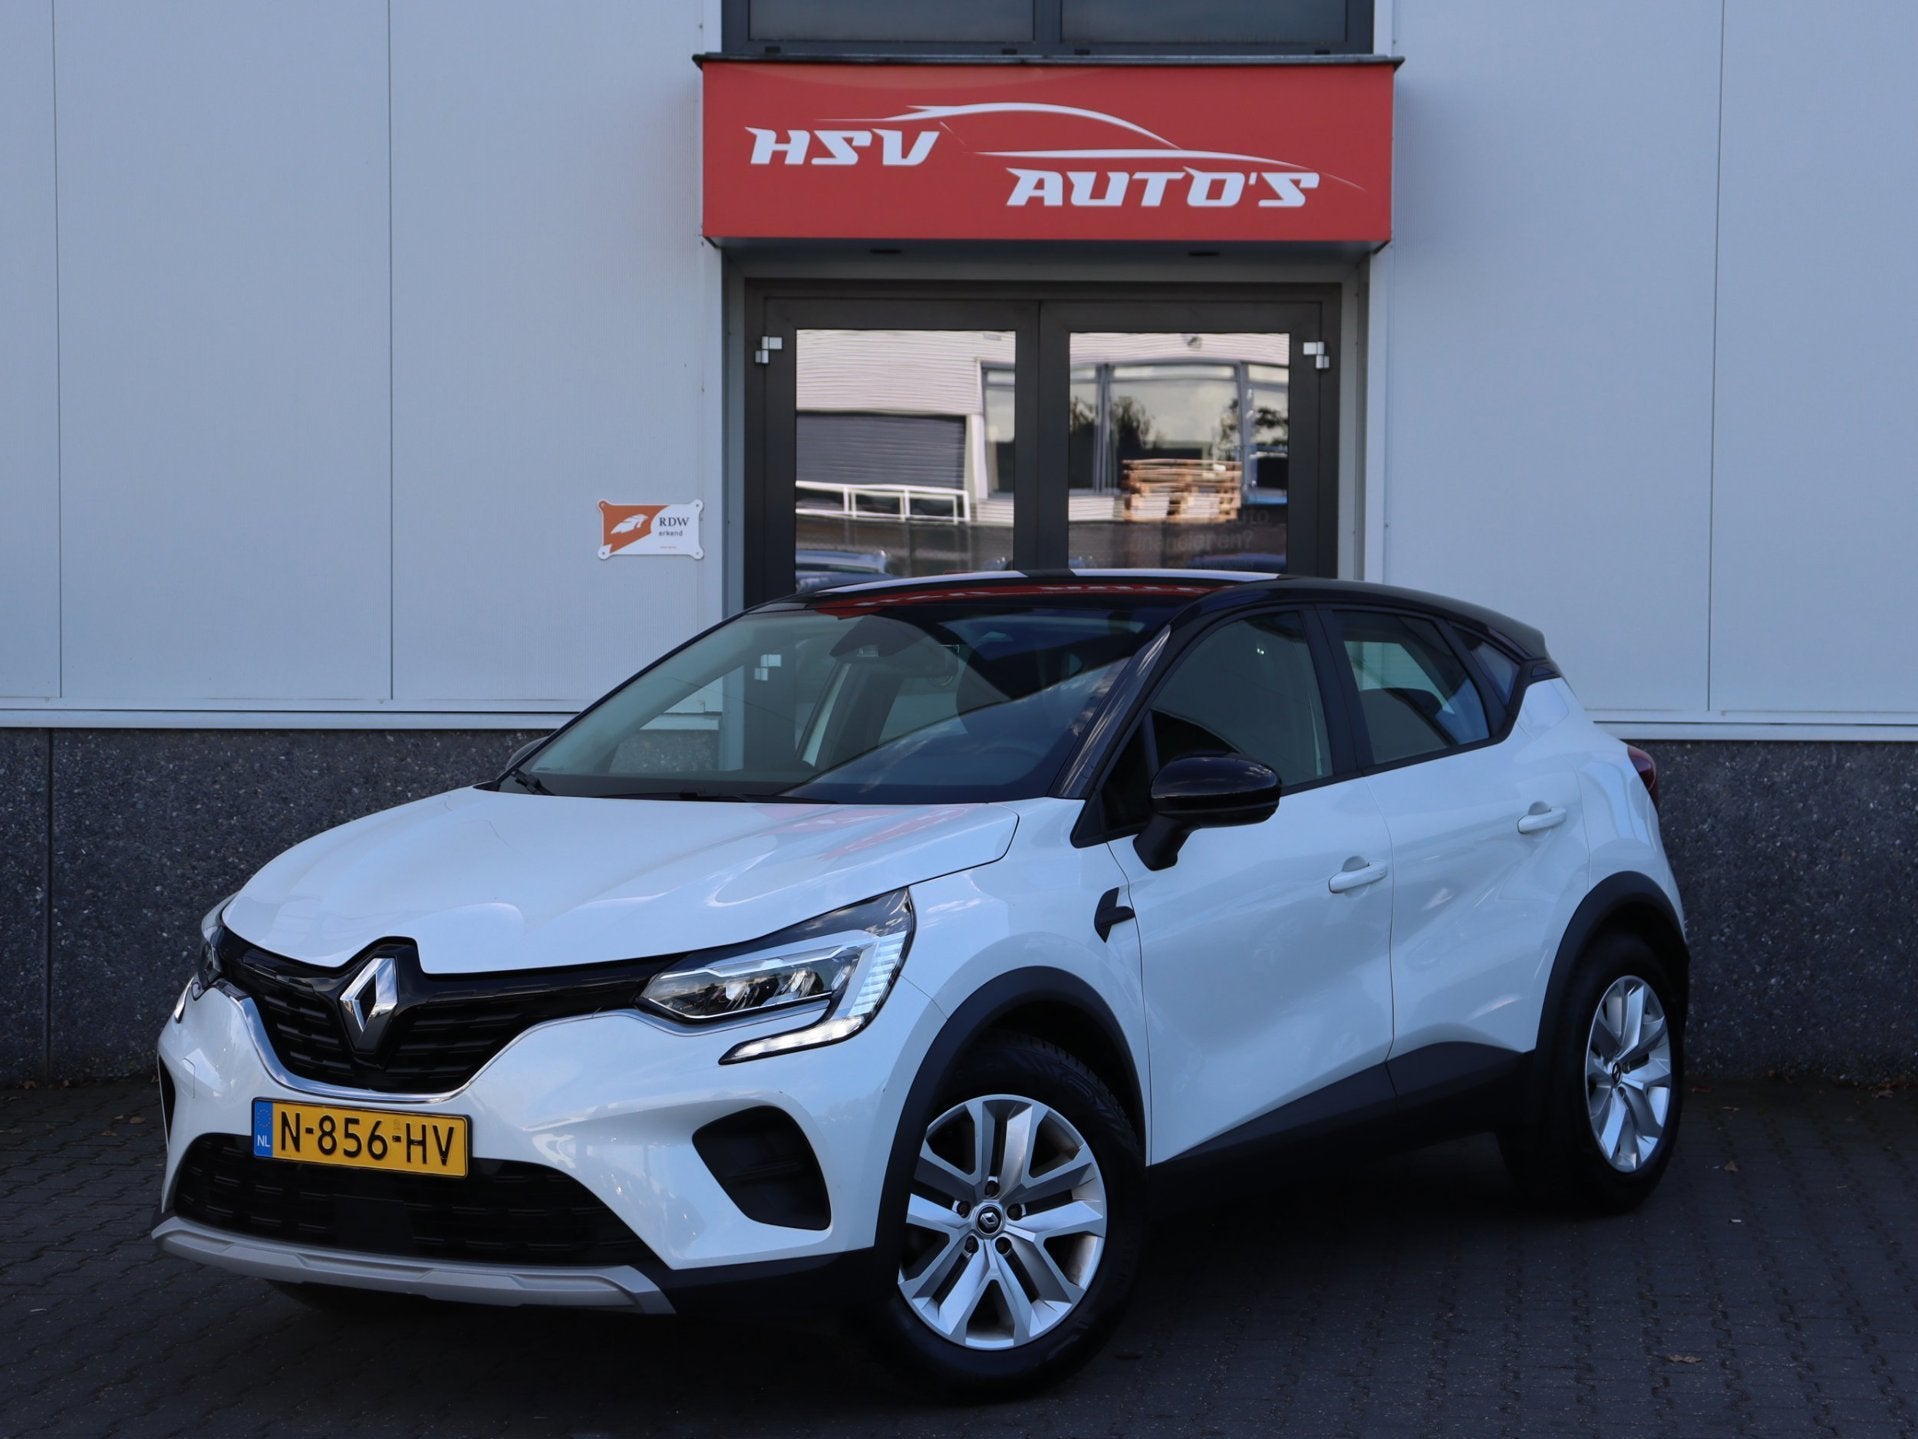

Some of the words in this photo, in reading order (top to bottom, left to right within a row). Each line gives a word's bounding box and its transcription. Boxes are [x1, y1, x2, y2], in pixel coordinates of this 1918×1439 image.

[745, 127, 939, 165] HSV
[1005, 166, 1320, 207] AUTO'S
[658, 517, 689, 527] RDW
[257, 1135, 270, 1147] NL
[281, 1111, 454, 1166] N-856-HV
